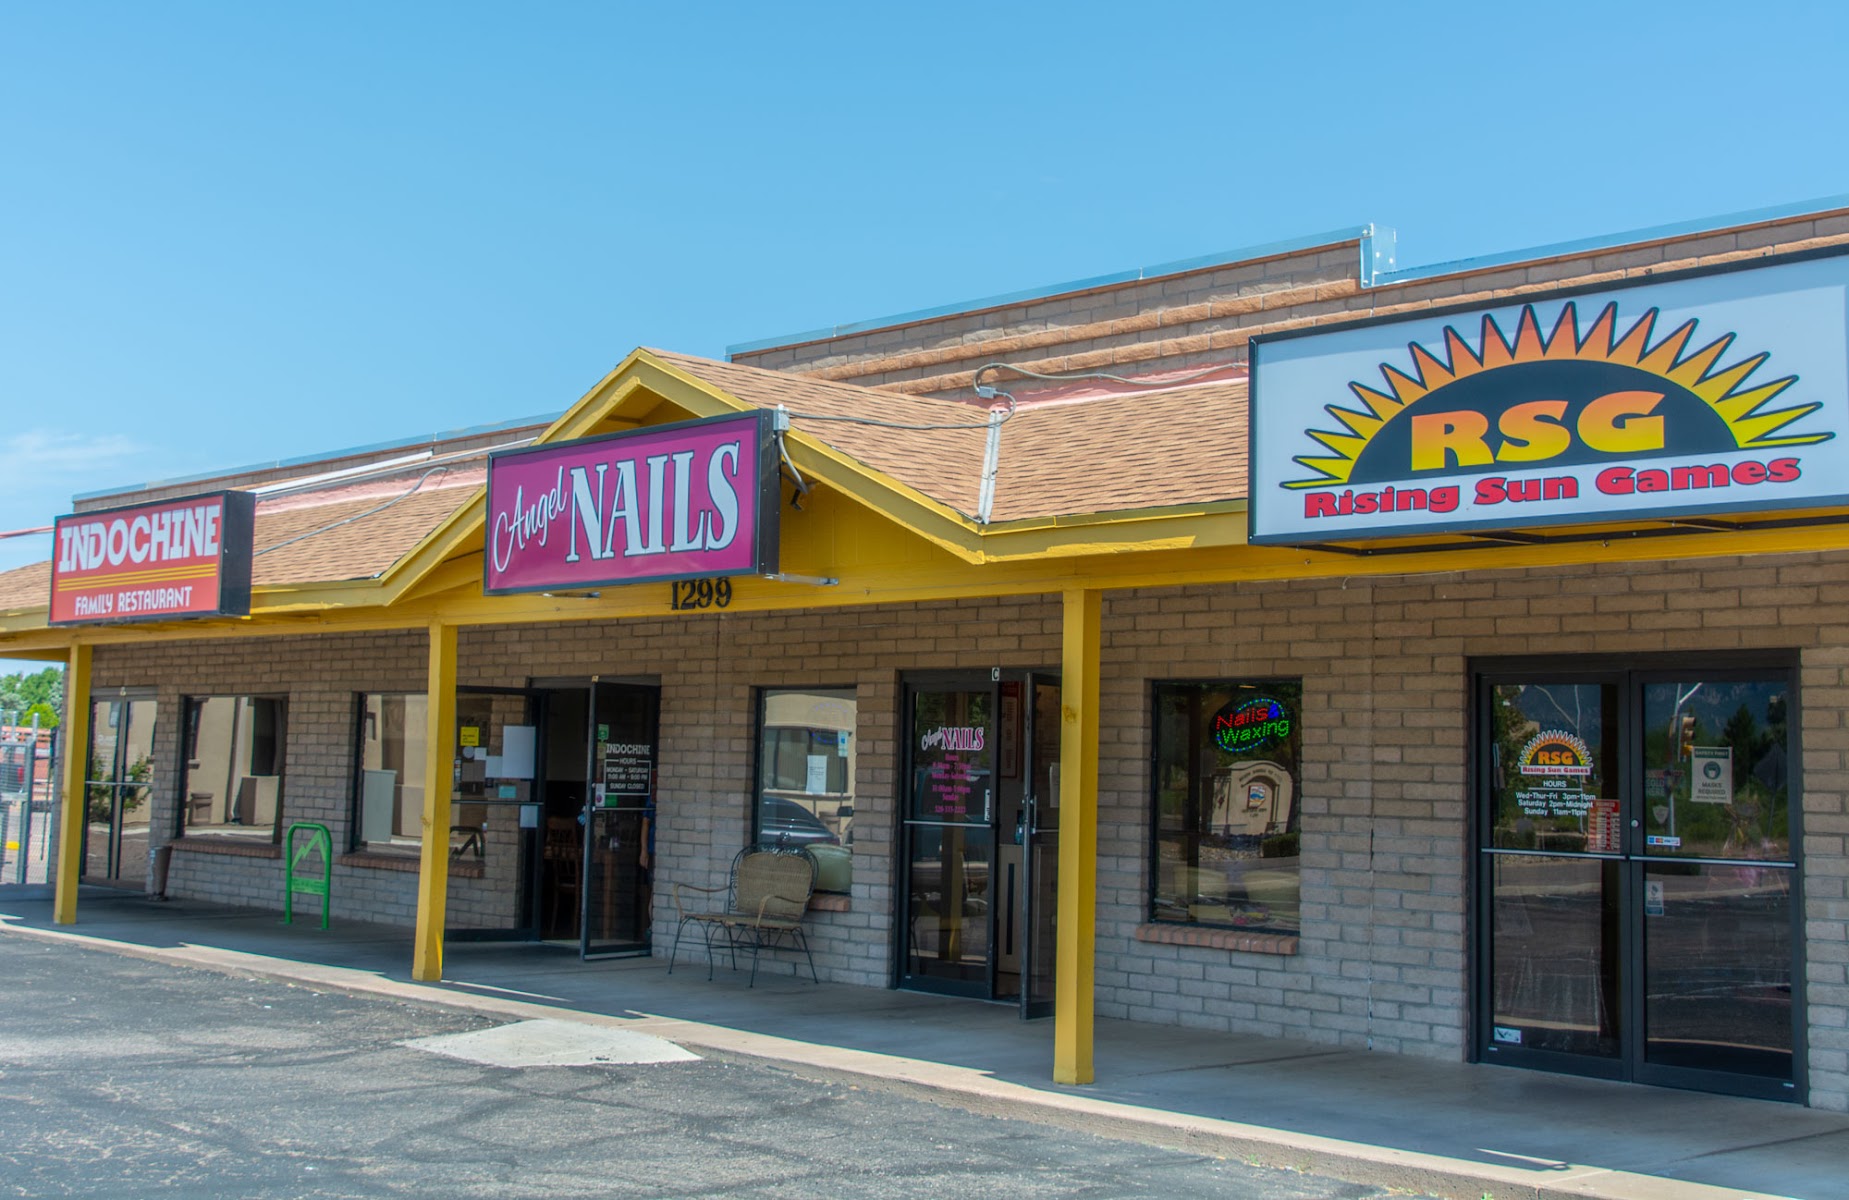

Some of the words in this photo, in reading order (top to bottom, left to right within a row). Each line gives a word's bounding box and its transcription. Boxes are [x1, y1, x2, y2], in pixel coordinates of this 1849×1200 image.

[1409, 389, 1666, 471] RSG
[1303, 484, 1461, 519] Rising
[1473, 474, 1579, 506] Sun
[1595, 457, 1802, 497] Games
[493, 465, 568, 573] Angel
[565, 440, 740, 563] NAILS
[58, 504, 221, 573] INDOCHINE
[75, 593, 113, 616] FAMILY
[117, 586, 193, 612] RESTAURANT
[671, 576, 732, 610] 1299
[1215, 707, 1269, 730] Nails
[940, 727, 985, 751] NAILS
[1221, 720, 1289, 744] Waxing
[606, 743, 651, 755] INDOCHINE
[1537, 751, 1573, 765] RSG
[1543, 780, 1567, 788] HOURS
[1516, 792, 1558, 800] Wed-Thur-Fri
[1562, 793, 1596, 802] 3pm-11pm
[1518, 800, 1546, 808] Saturday
[1548, 801, 1594, 809] 2pm-Midnight
[1524, 808, 1548, 816] Sunday
[1553, 808, 1587, 817] 11am-11pm
